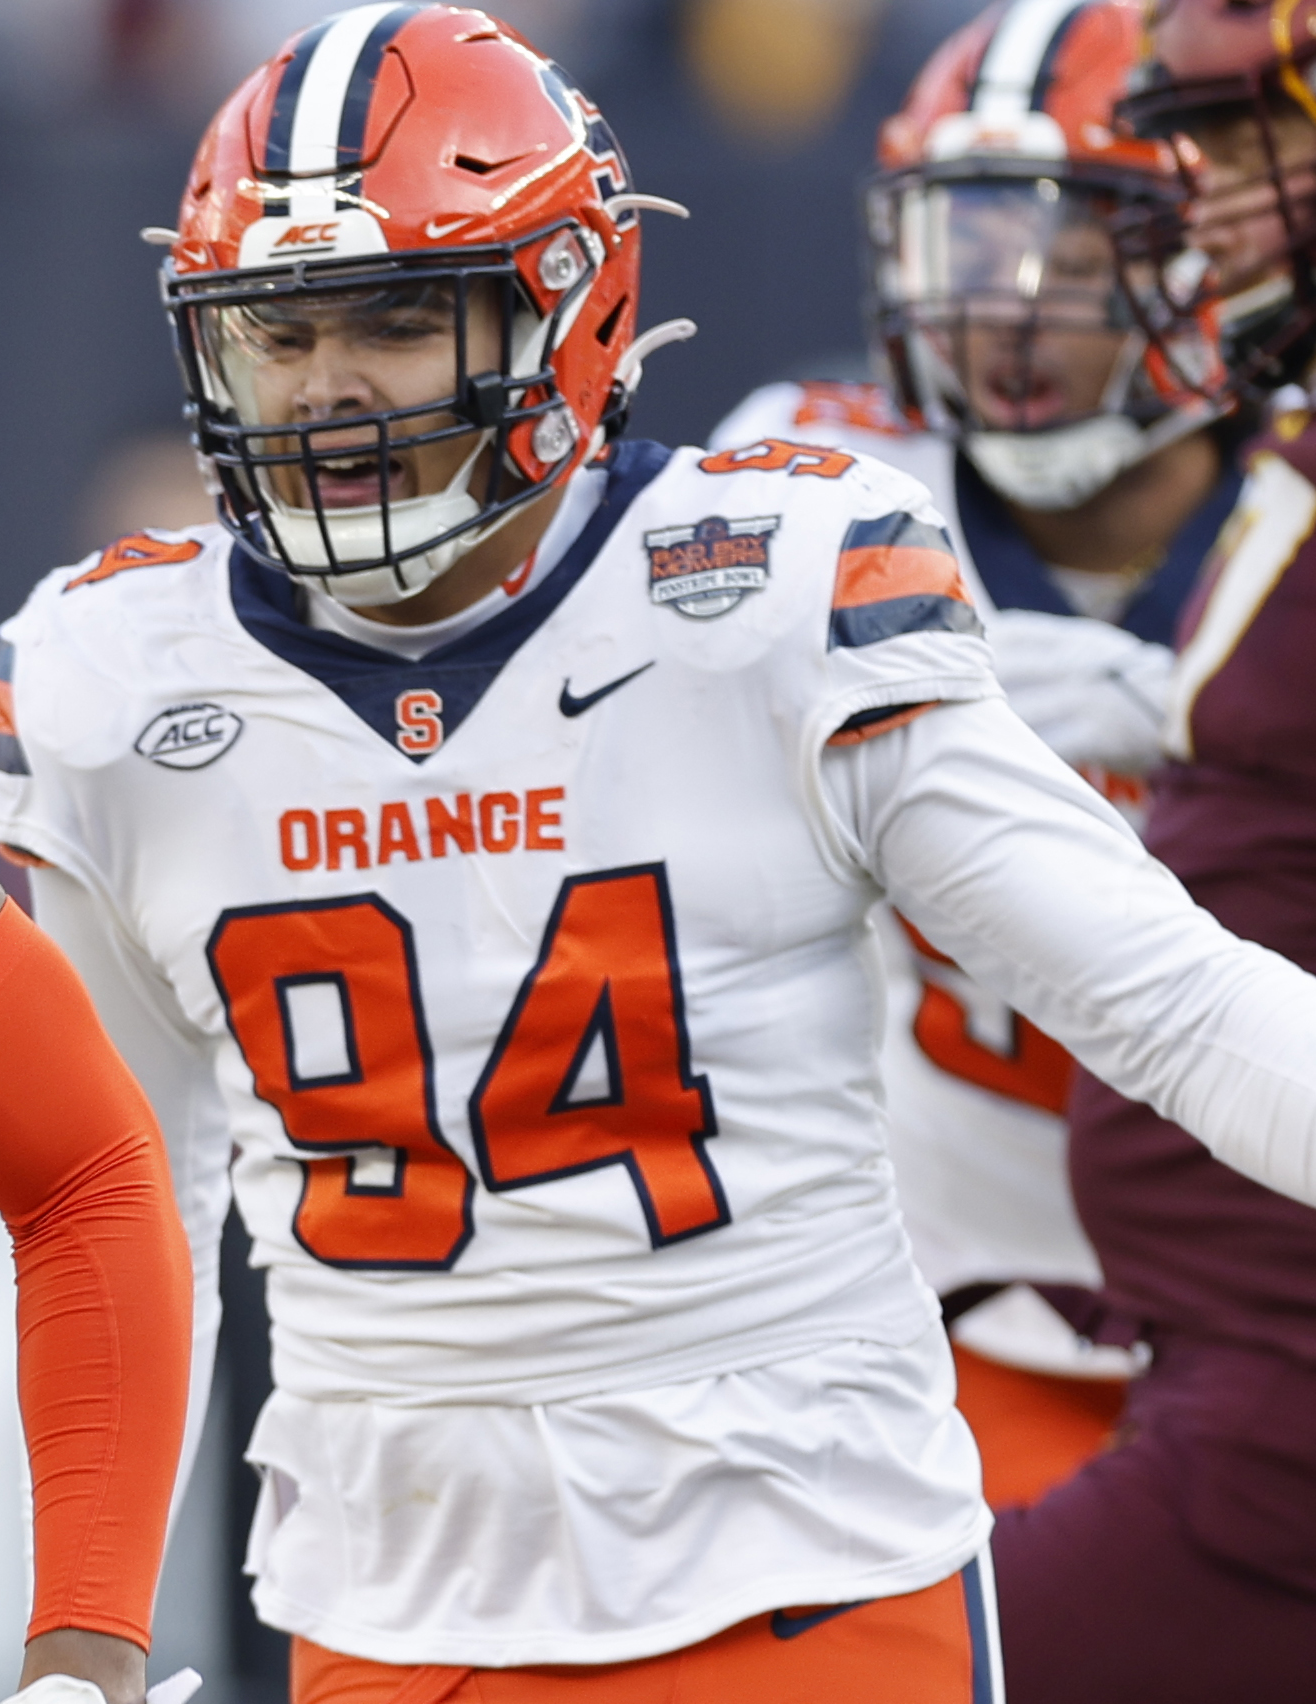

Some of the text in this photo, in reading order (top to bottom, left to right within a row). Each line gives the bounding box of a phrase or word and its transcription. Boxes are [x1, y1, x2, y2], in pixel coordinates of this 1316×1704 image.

[274, 222, 340, 247] ACC
[154, 713, 225, 751] ACC
[395, 688, 444, 756] S
[278, 785, 566, 873] ORANGE
[204, 860, 733, 1272] 94
